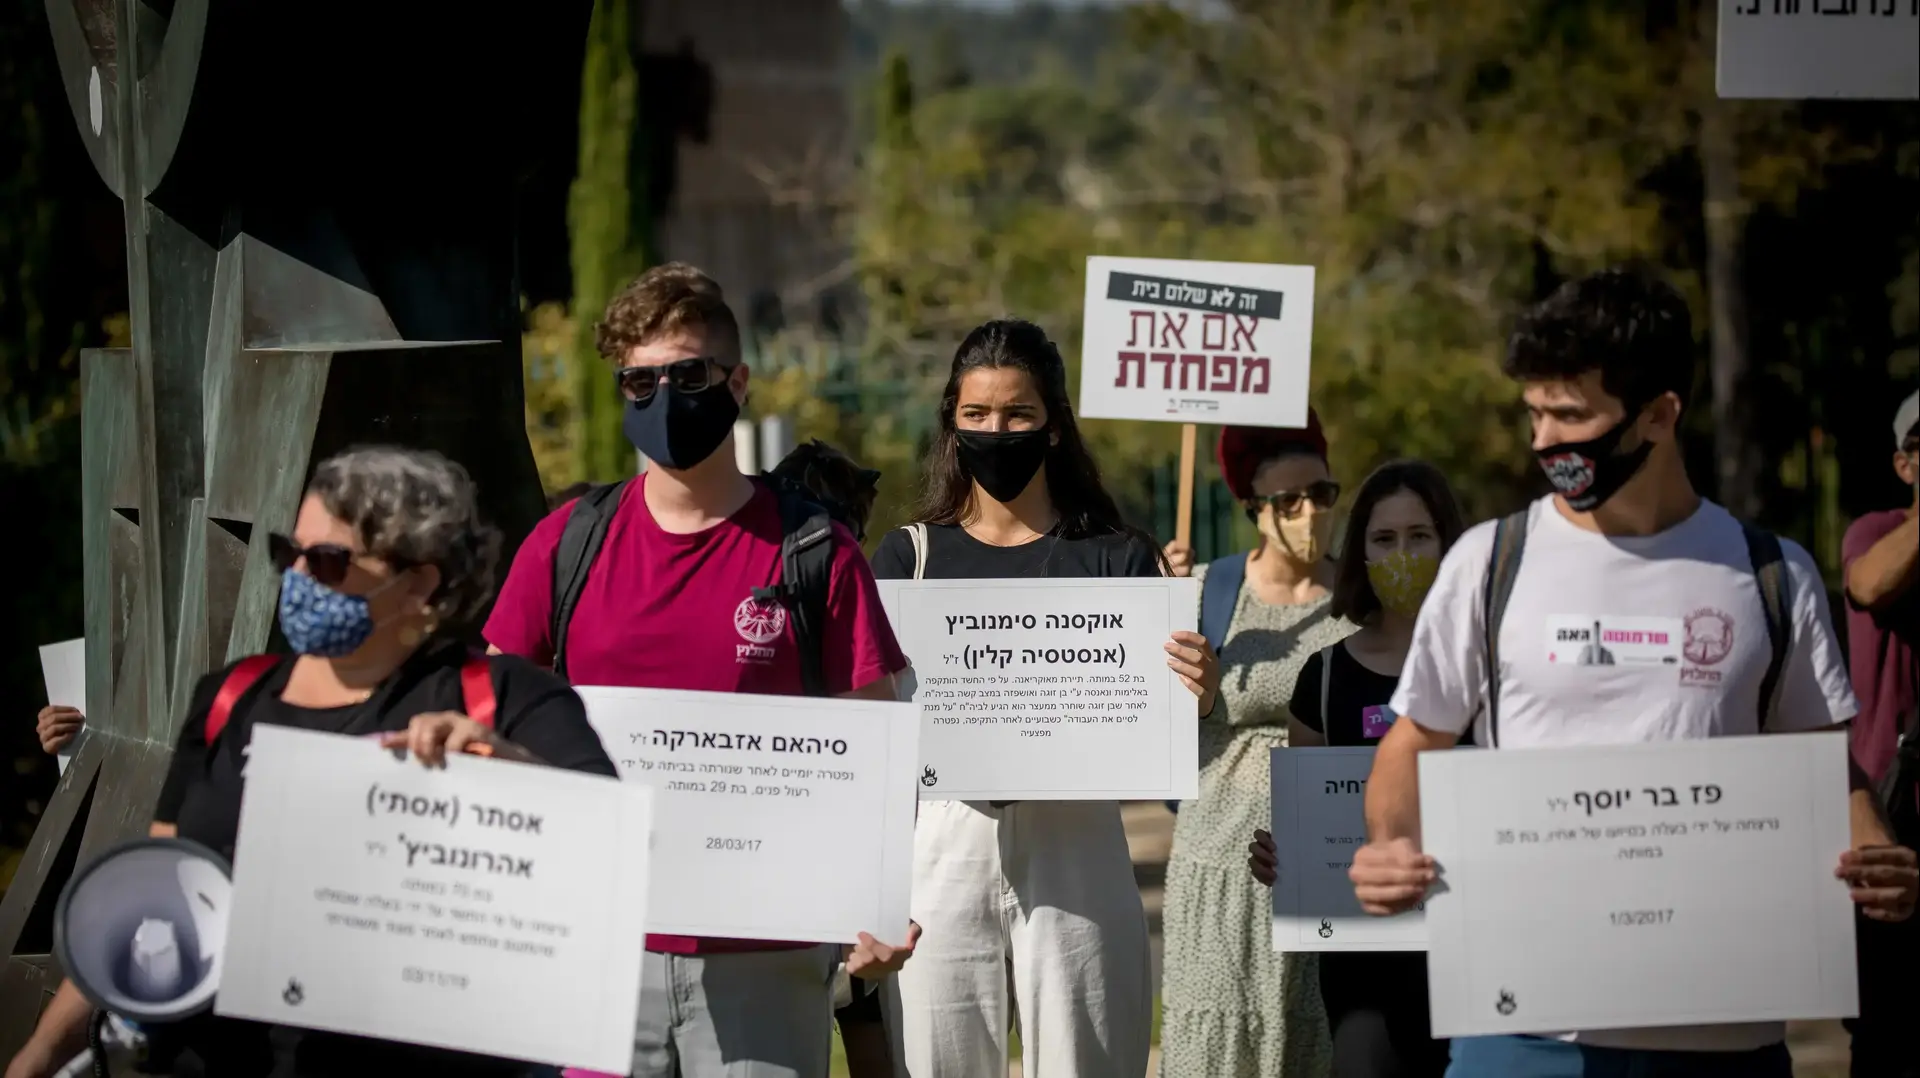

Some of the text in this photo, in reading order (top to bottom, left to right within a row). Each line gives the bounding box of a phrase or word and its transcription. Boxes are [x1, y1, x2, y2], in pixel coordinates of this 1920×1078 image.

[1131, 280, 1258, 311] זה לא שלום בית
[1126, 310, 1260, 352] אם את
[1114, 351, 1271, 394] מפחדת
[945, 613, 1124, 635] אוקסנה סימנוביץ
[963, 644, 1013, 670] קלין)
[1021, 643, 1127, 668] (אנסטסיה
[925, 677, 958, 686] הותקפה
[998, 675, 1009, 684] על
[1118, 674, 1130, 683] 52
[957, 690, 977, 699] קשה
[978, 690, 1001, 698] במצב
[1003, 690, 1037, 698] ואושפזה
[1040, 689, 1056, 697] זוגה
[1059, 689, 1068, 698] בן
[1084, 689, 1112, 697] ונאנסה
[1114, 688, 1148, 697] באלימות
[923, 704, 940, 712] מנת
[990, 703, 1009, 711] הגיע
[1028, 703, 1057, 711] ממעצר
[1059, 702, 1085, 710] שוחרר
[1088, 702, 1104, 710] זוגה
[1107, 702, 1122, 711] שבן
[1125, 701, 1147, 710] לאחר
[933, 717, 960, 725] נפטרה
[1000, 715, 1023, 724] לאחר
[1116, 714, 1138, 723] לסיים
[652, 729, 762, 752] אזבארקה
[772, 736, 848, 756] סיהאם
[639, 758, 654, 770] על
[657, 761, 694, 772] בביתה
[748, 765, 777, 777] לאחר
[781, 767, 813, 779] יומיים
[816, 769, 855, 781] נפטרה
[710, 780, 726, 793] 29
[731, 784, 747, 794] בת
[784, 784, 810, 797] רעול
[1642, 785, 1679, 807] בר
[1689, 783, 1723, 806] פז
[1573, 788, 1631, 816] יוסף
[366, 782, 545, 835] אסתר (אסתי)
[706, 837, 763, 852] 28/03/17
[1610, 908, 1675, 926] 1/3/2017
